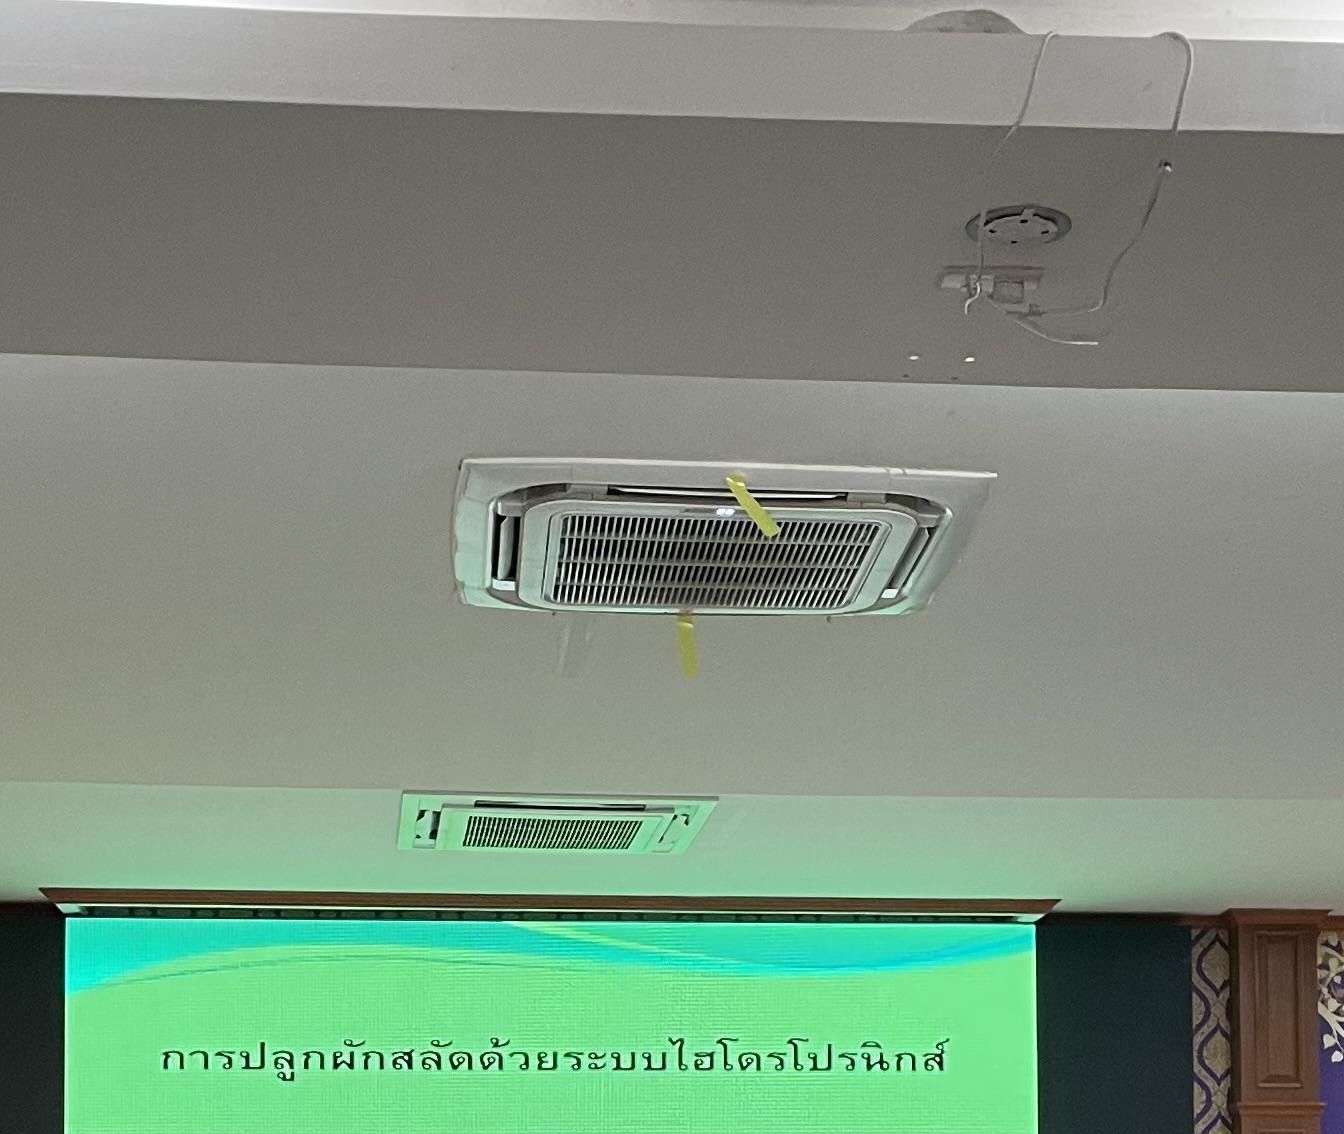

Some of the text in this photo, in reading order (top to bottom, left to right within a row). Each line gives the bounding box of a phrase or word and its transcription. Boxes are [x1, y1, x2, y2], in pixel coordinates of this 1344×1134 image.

[161, 1036, 949, 1082] การปลูกผักสลัดด้วยระบบไฮโดรโปรนิกส์
